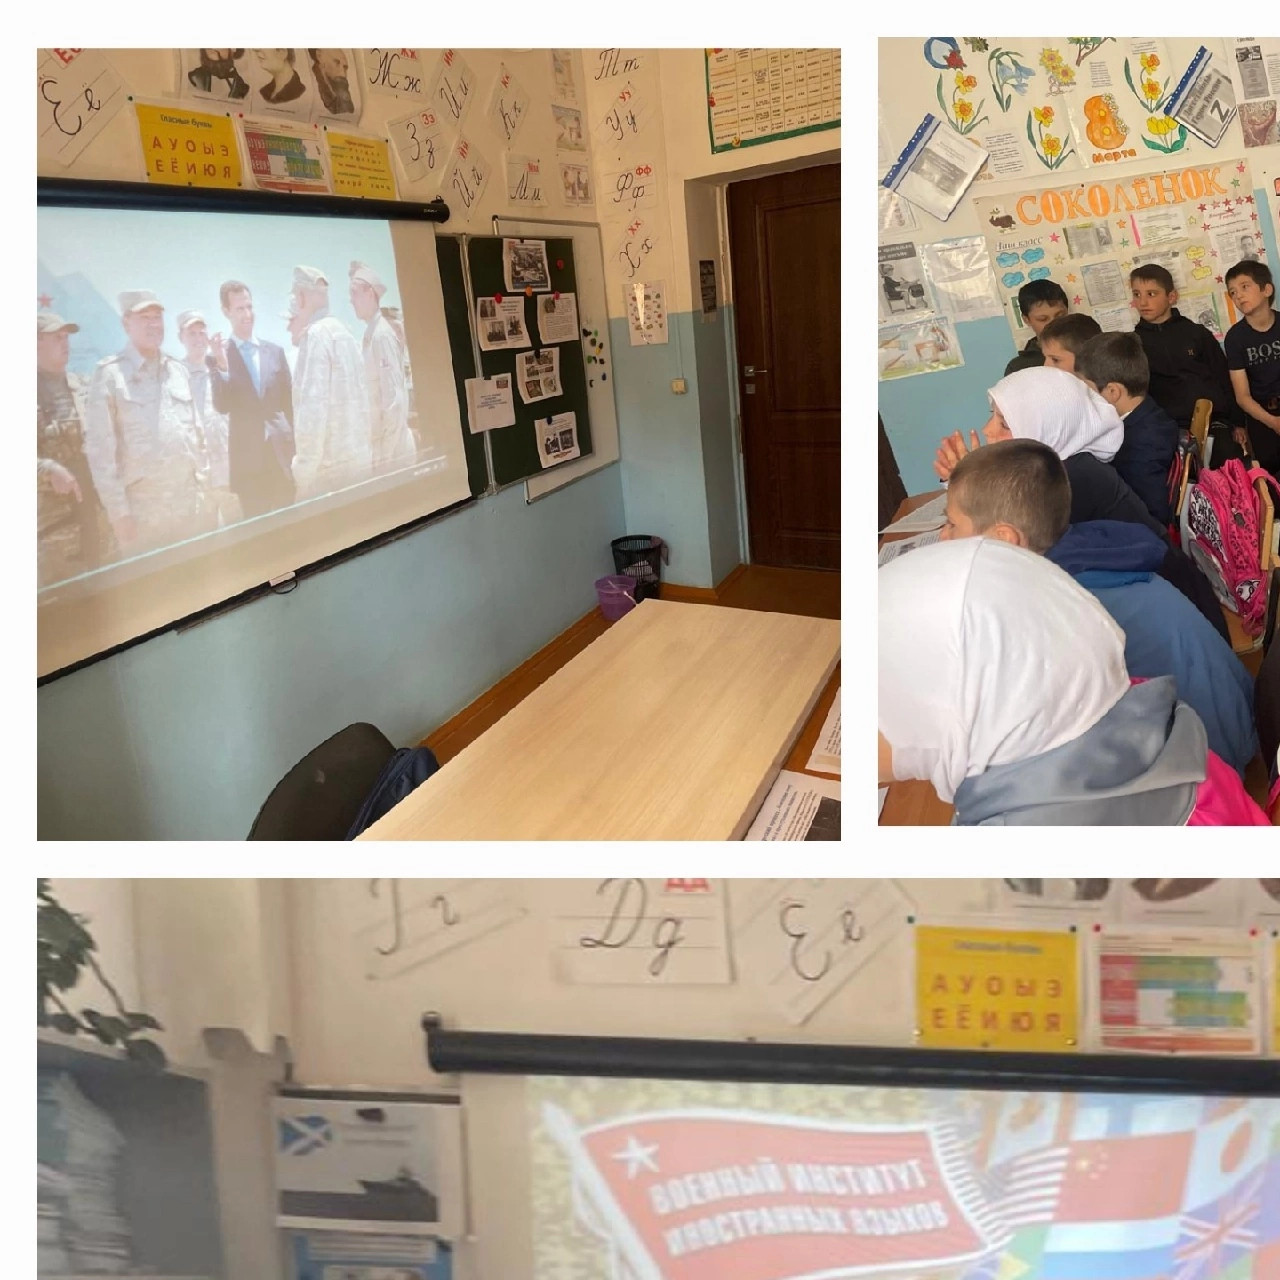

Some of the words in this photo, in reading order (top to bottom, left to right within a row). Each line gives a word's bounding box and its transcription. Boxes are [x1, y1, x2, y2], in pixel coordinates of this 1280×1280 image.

[1084, 95, 1128, 150] 8
[1210, 99, 1230, 124] Z
[1016, 168, 1227, 225] СОКОЛЁНОК
[648, 1157, 785, 1216] ВОЕННЫЙ
[796, 1158, 928, 1198] ИНСТИТУТ
[663, 1205, 848, 1258] ИНОСТРАННЫХ
[852, 1199, 949, 1238] ЯЗЫКОВ
